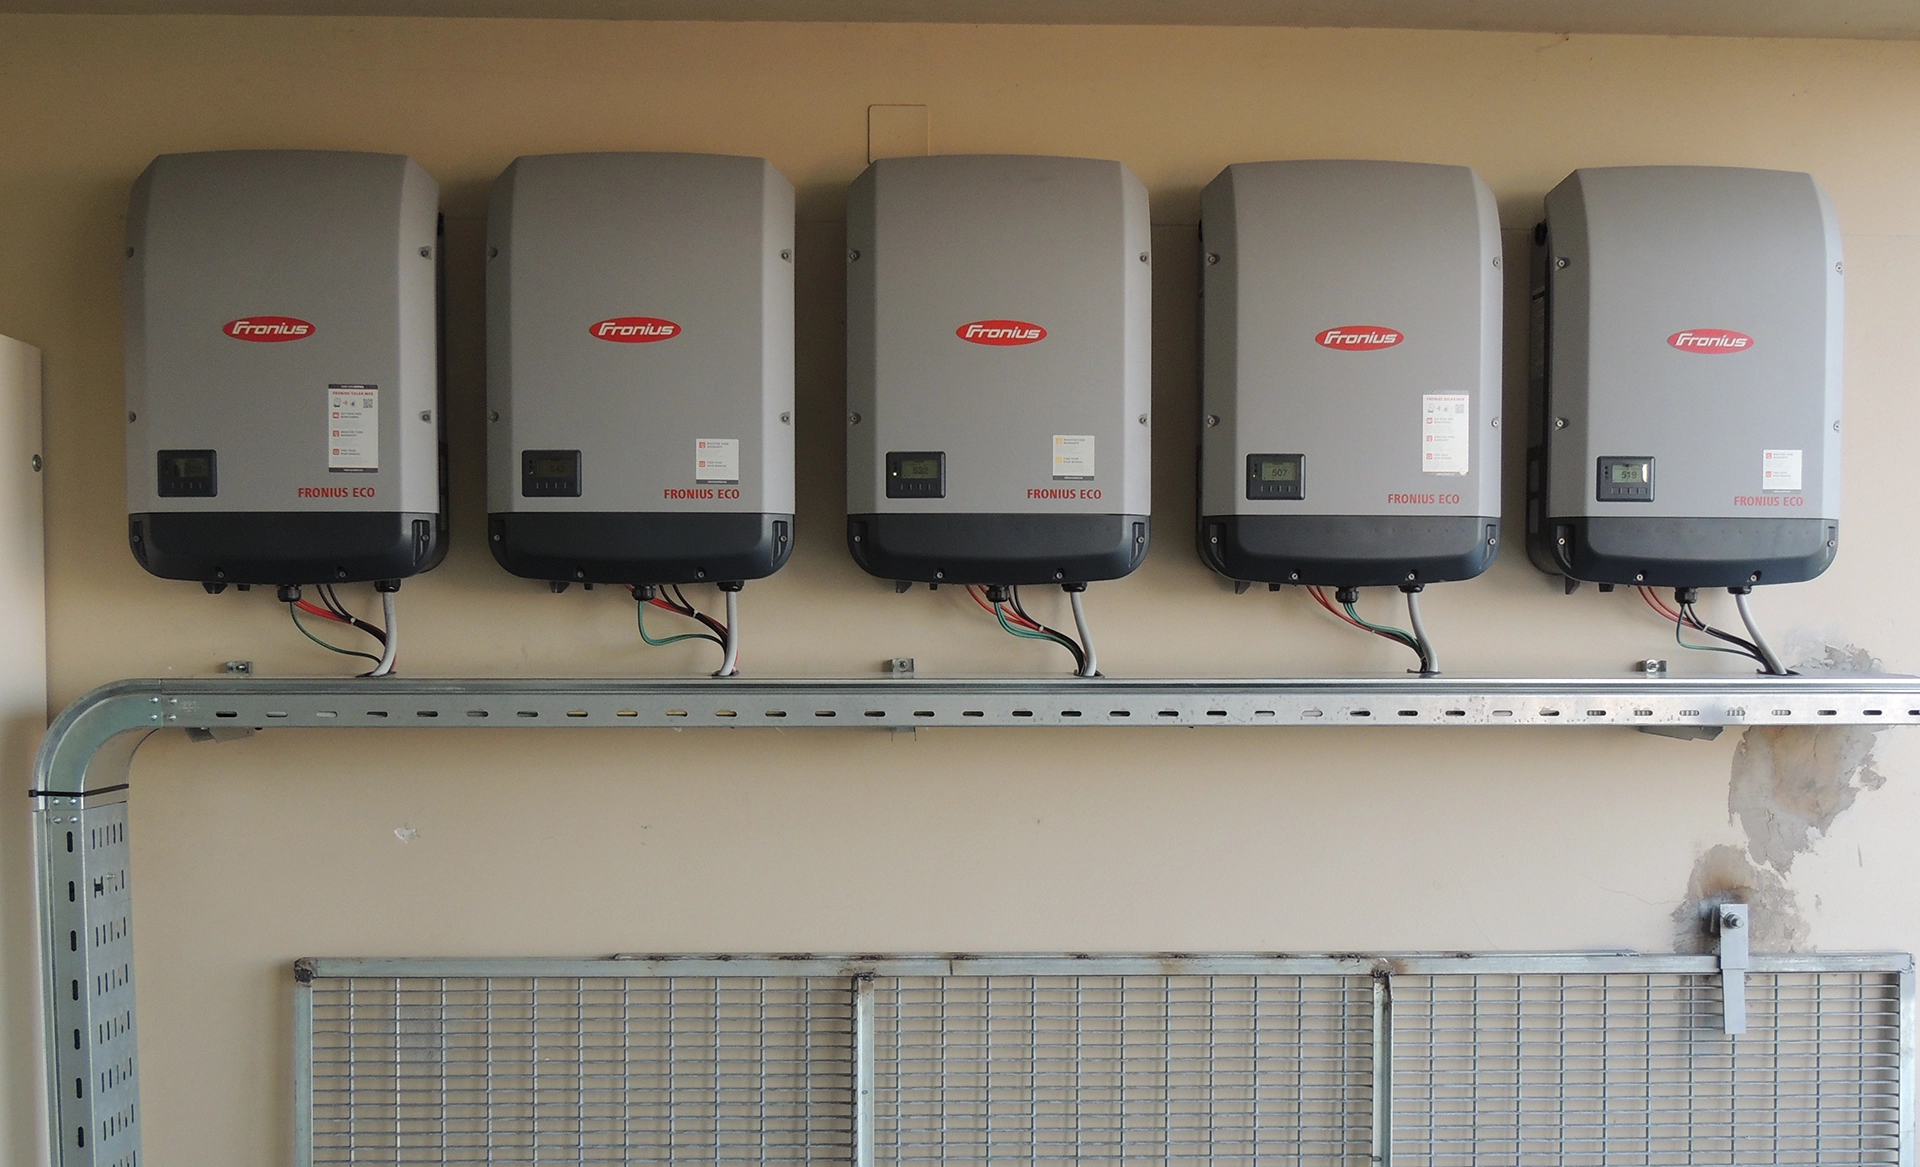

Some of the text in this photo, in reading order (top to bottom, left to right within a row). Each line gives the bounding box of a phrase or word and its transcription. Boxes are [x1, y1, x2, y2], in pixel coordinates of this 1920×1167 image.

[232, 321, 309, 335] Fronius
[598, 322, 674, 336] Fronius
[965, 324, 1041, 339] Fronius
[1324, 330, 1397, 344] Fronius
[1675, 333, 1748, 347] Fronius
[1272, 468, 1288, 477] 507
[1621, 471, 1638, 479] 519
[298, 487, 375, 498] FRONIUS ECO
[664, 489, 740, 499] FRONIUS ECO
[1027, 489, 1102, 499] FRONIUS ECO
[1388, 494, 1460, 504] FRONIUS ECO
[1734, 496, 1804, 506] FRONIUS ECO
